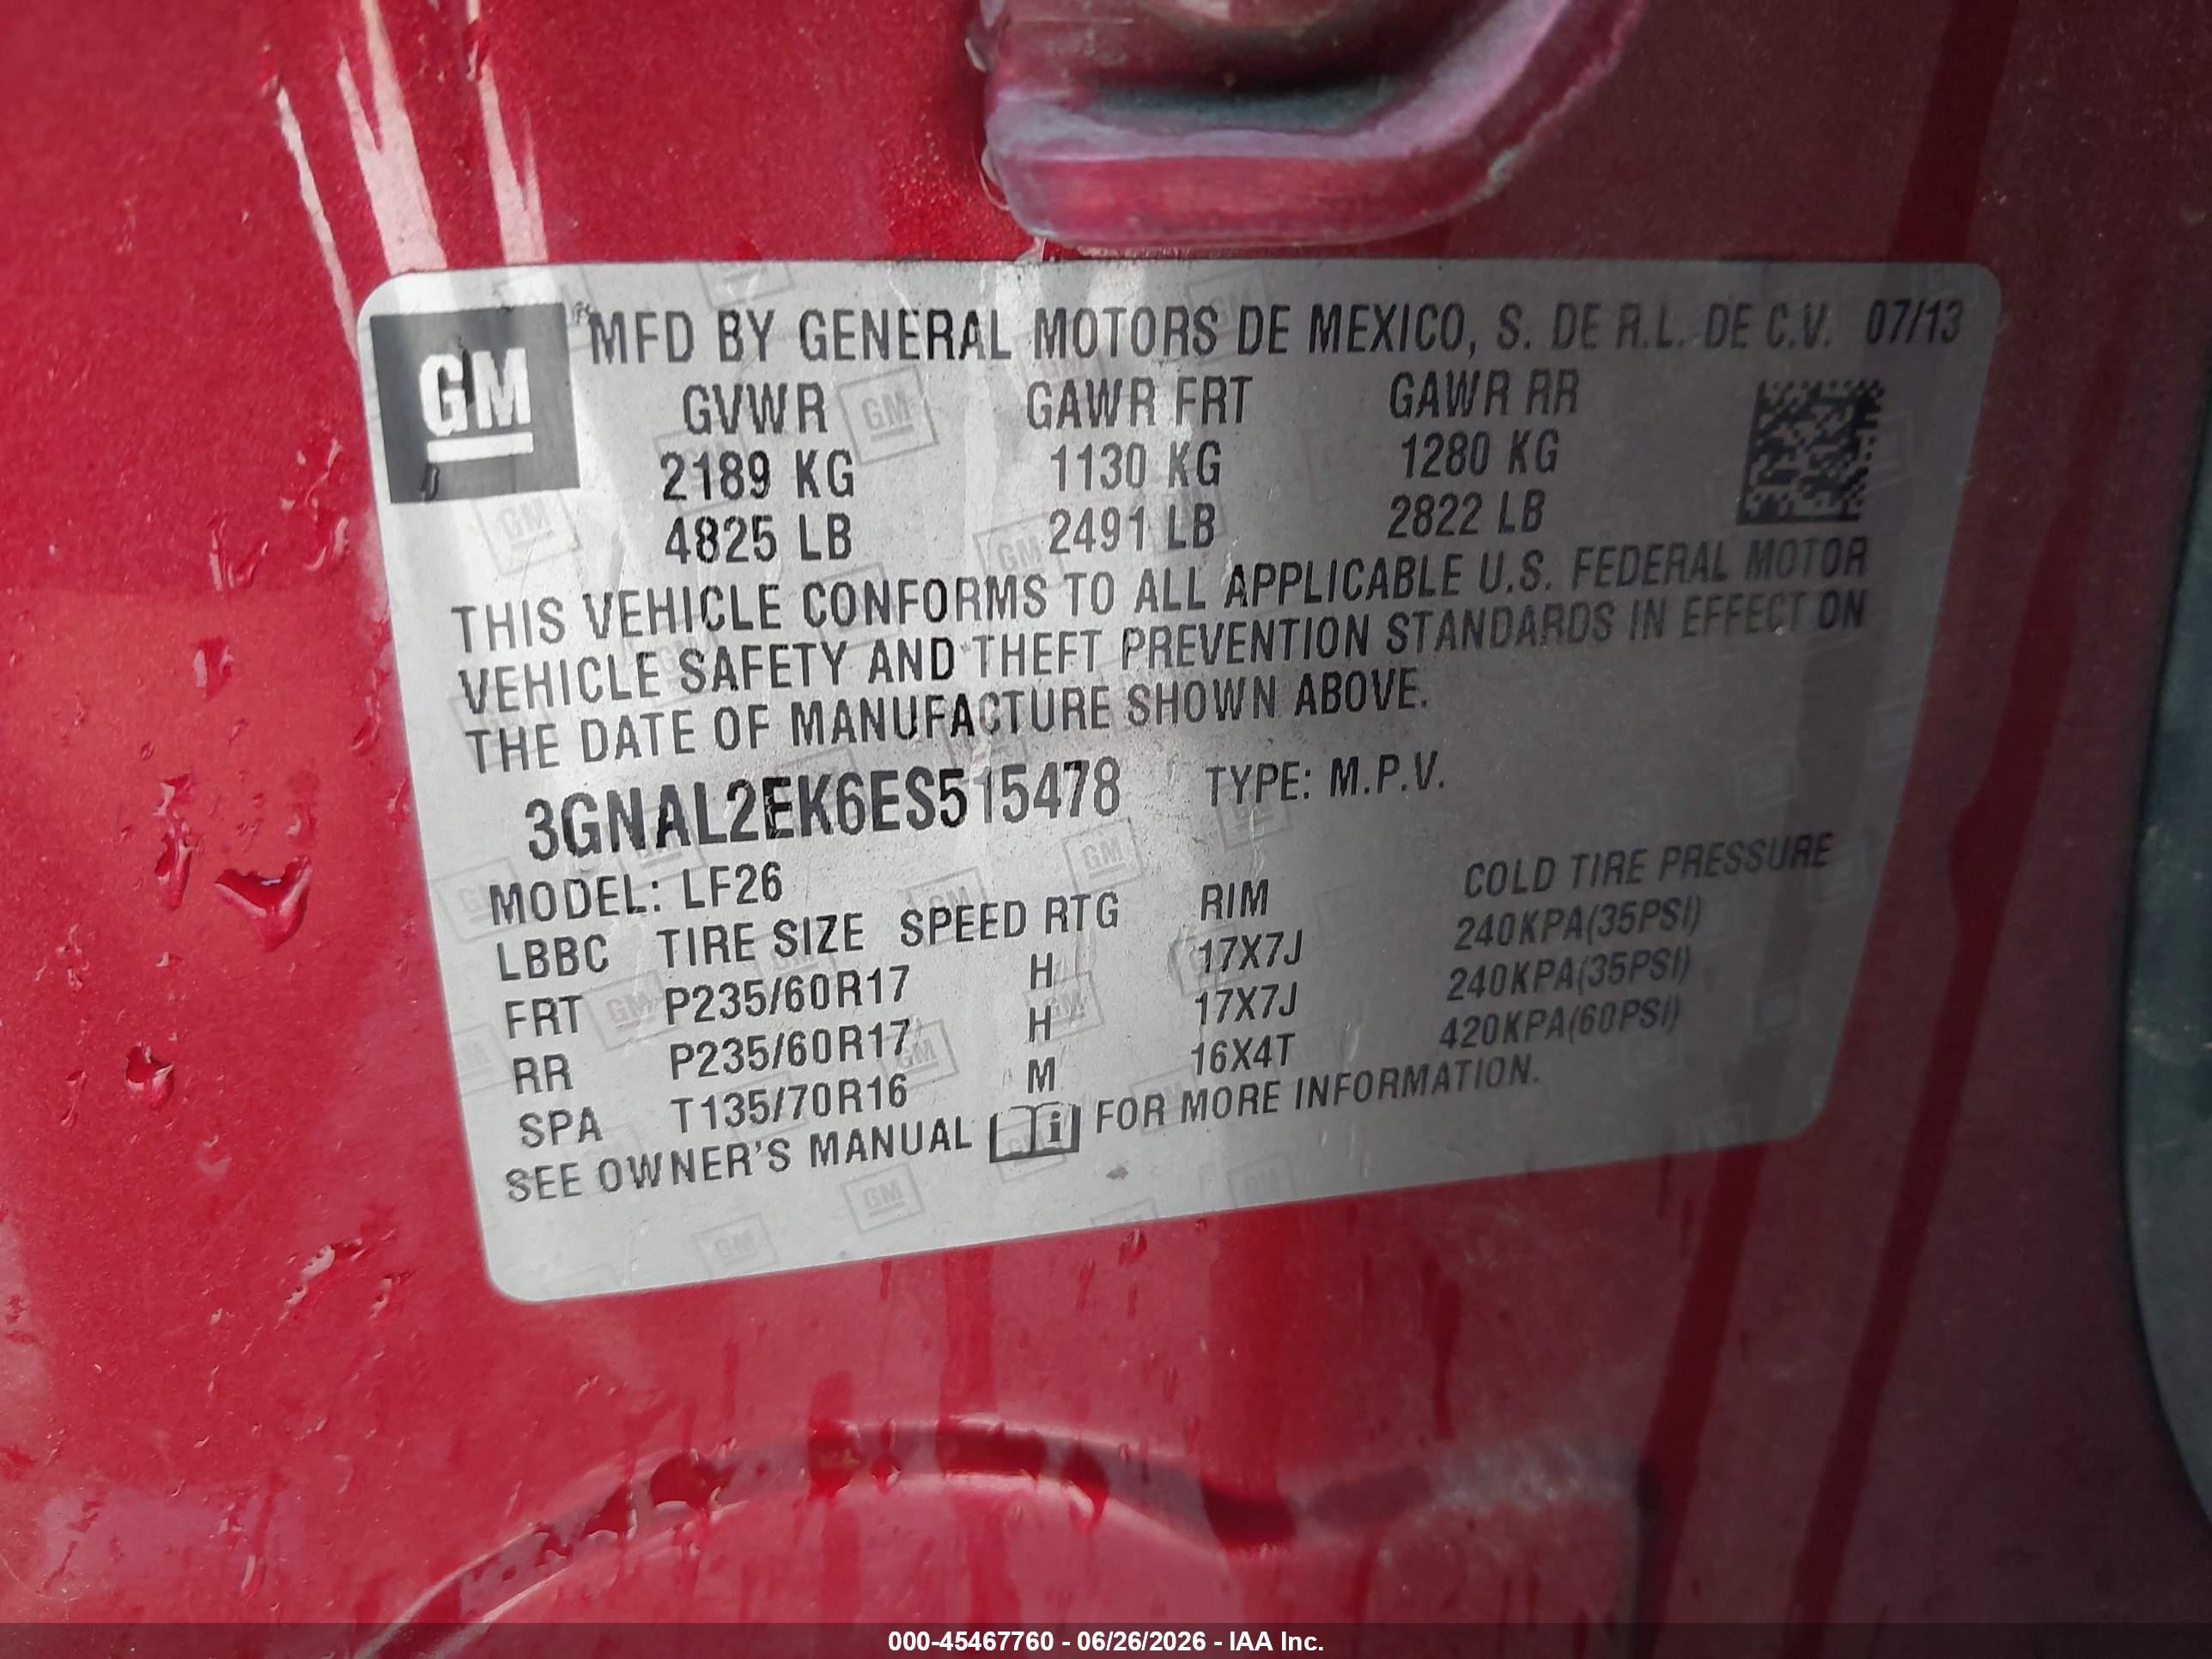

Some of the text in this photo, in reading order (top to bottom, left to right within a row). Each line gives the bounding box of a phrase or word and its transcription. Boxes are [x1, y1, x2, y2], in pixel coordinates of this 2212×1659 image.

[588, 299, 1965, 364] MFD BY GENERAL MOTORS DE MEXICO, S. DE R.L. DE C.V. 07/13
[419, 347, 532, 436] GM
[684, 382, 828, 434] GVWR
[862, 386, 911, 428] GM
[1027, 375, 1254, 429] GAWR FRT
[1389, 368, 1580, 419] GAWR RR
[660, 448, 854, 501] 2189 KG
[1050, 440, 1222, 492] 1130 KG
[1401, 428, 1559, 479] 1280 KG
[665, 513, 852, 563] 4825 LB
[1048, 501, 1214, 555] 2491 LB
[1387, 489, 1545, 539] 2822 LB
[452, 536, 1869, 653] THIS VEHICLE CONFORMS TO ALL APPLICABLE U.S. FEDERAL MOTOR
[459, 651, 660, 714] VEHICLE
[678, 639, 848, 695] SAFETY
[866, 635, 955, 684] AND
[972, 629, 1103, 679] THEFT
[1121, 614, 1370, 671] PREVENTION
[1386, 599, 1613, 655] STANDARDS
[1631, 599, 1664, 641] IN
[1680, 592, 1802, 639] EFFECT
[1817, 589, 1868, 630] ON
[465, 667, 1428, 773] THE DATE OF MANUFACTURE SHOWN ABOVE.
[1204, 750, 1446, 806] TYPE: M.P.V.
[525, 756, 1120, 860] 3GNAL2EK6ES515478
[1462, 832, 1834, 899] COLD TIRE PRESSURE
[489, 876, 663, 927] MODEL:
[682, 861, 784, 910] LF26
[899, 890, 1121, 949] SPEED RTG
[1200, 878, 1269, 923] RIM
[657, 922, 757, 969] TIRE
[772, 912, 866, 958] SIZE
[1454, 894, 1704, 951] 240KPA(35PSI)
[497, 933, 610, 982] LBBC
[1030, 951, 1054, 989] H
[1198, 928, 1304, 975] 17X7J
[1446, 945, 1692, 1002] 240KPA(35PSI)
[504, 994, 585, 1040] FRT
[665, 963, 911, 1026] P235/60R17
[1194, 982, 1298, 1027] 17X7J
[670, 1018, 910, 1081] P235/60R17
[1028, 1006, 1054, 1043] H
[1438, 995, 1681, 1052] 420KPA(60PSI)
[513, 1052, 573, 1095] RR
[1027, 1056, 1056, 1095] M
[1189, 1032, 1296, 1077] 16X4T
[670, 1072, 908, 1135] T135/70R16
[1095, 1084, 1168, 1134] FOR
[1180, 1076, 1281, 1125] MORE
[1294, 1054, 1540, 1111] INFORMATION.
[520, 1106, 605, 1151] SPA
[506, 1159, 583, 1203] SEE
[599, 1138, 793, 1193] OWNER'S
[809, 1115, 973, 1169] MANUAL
